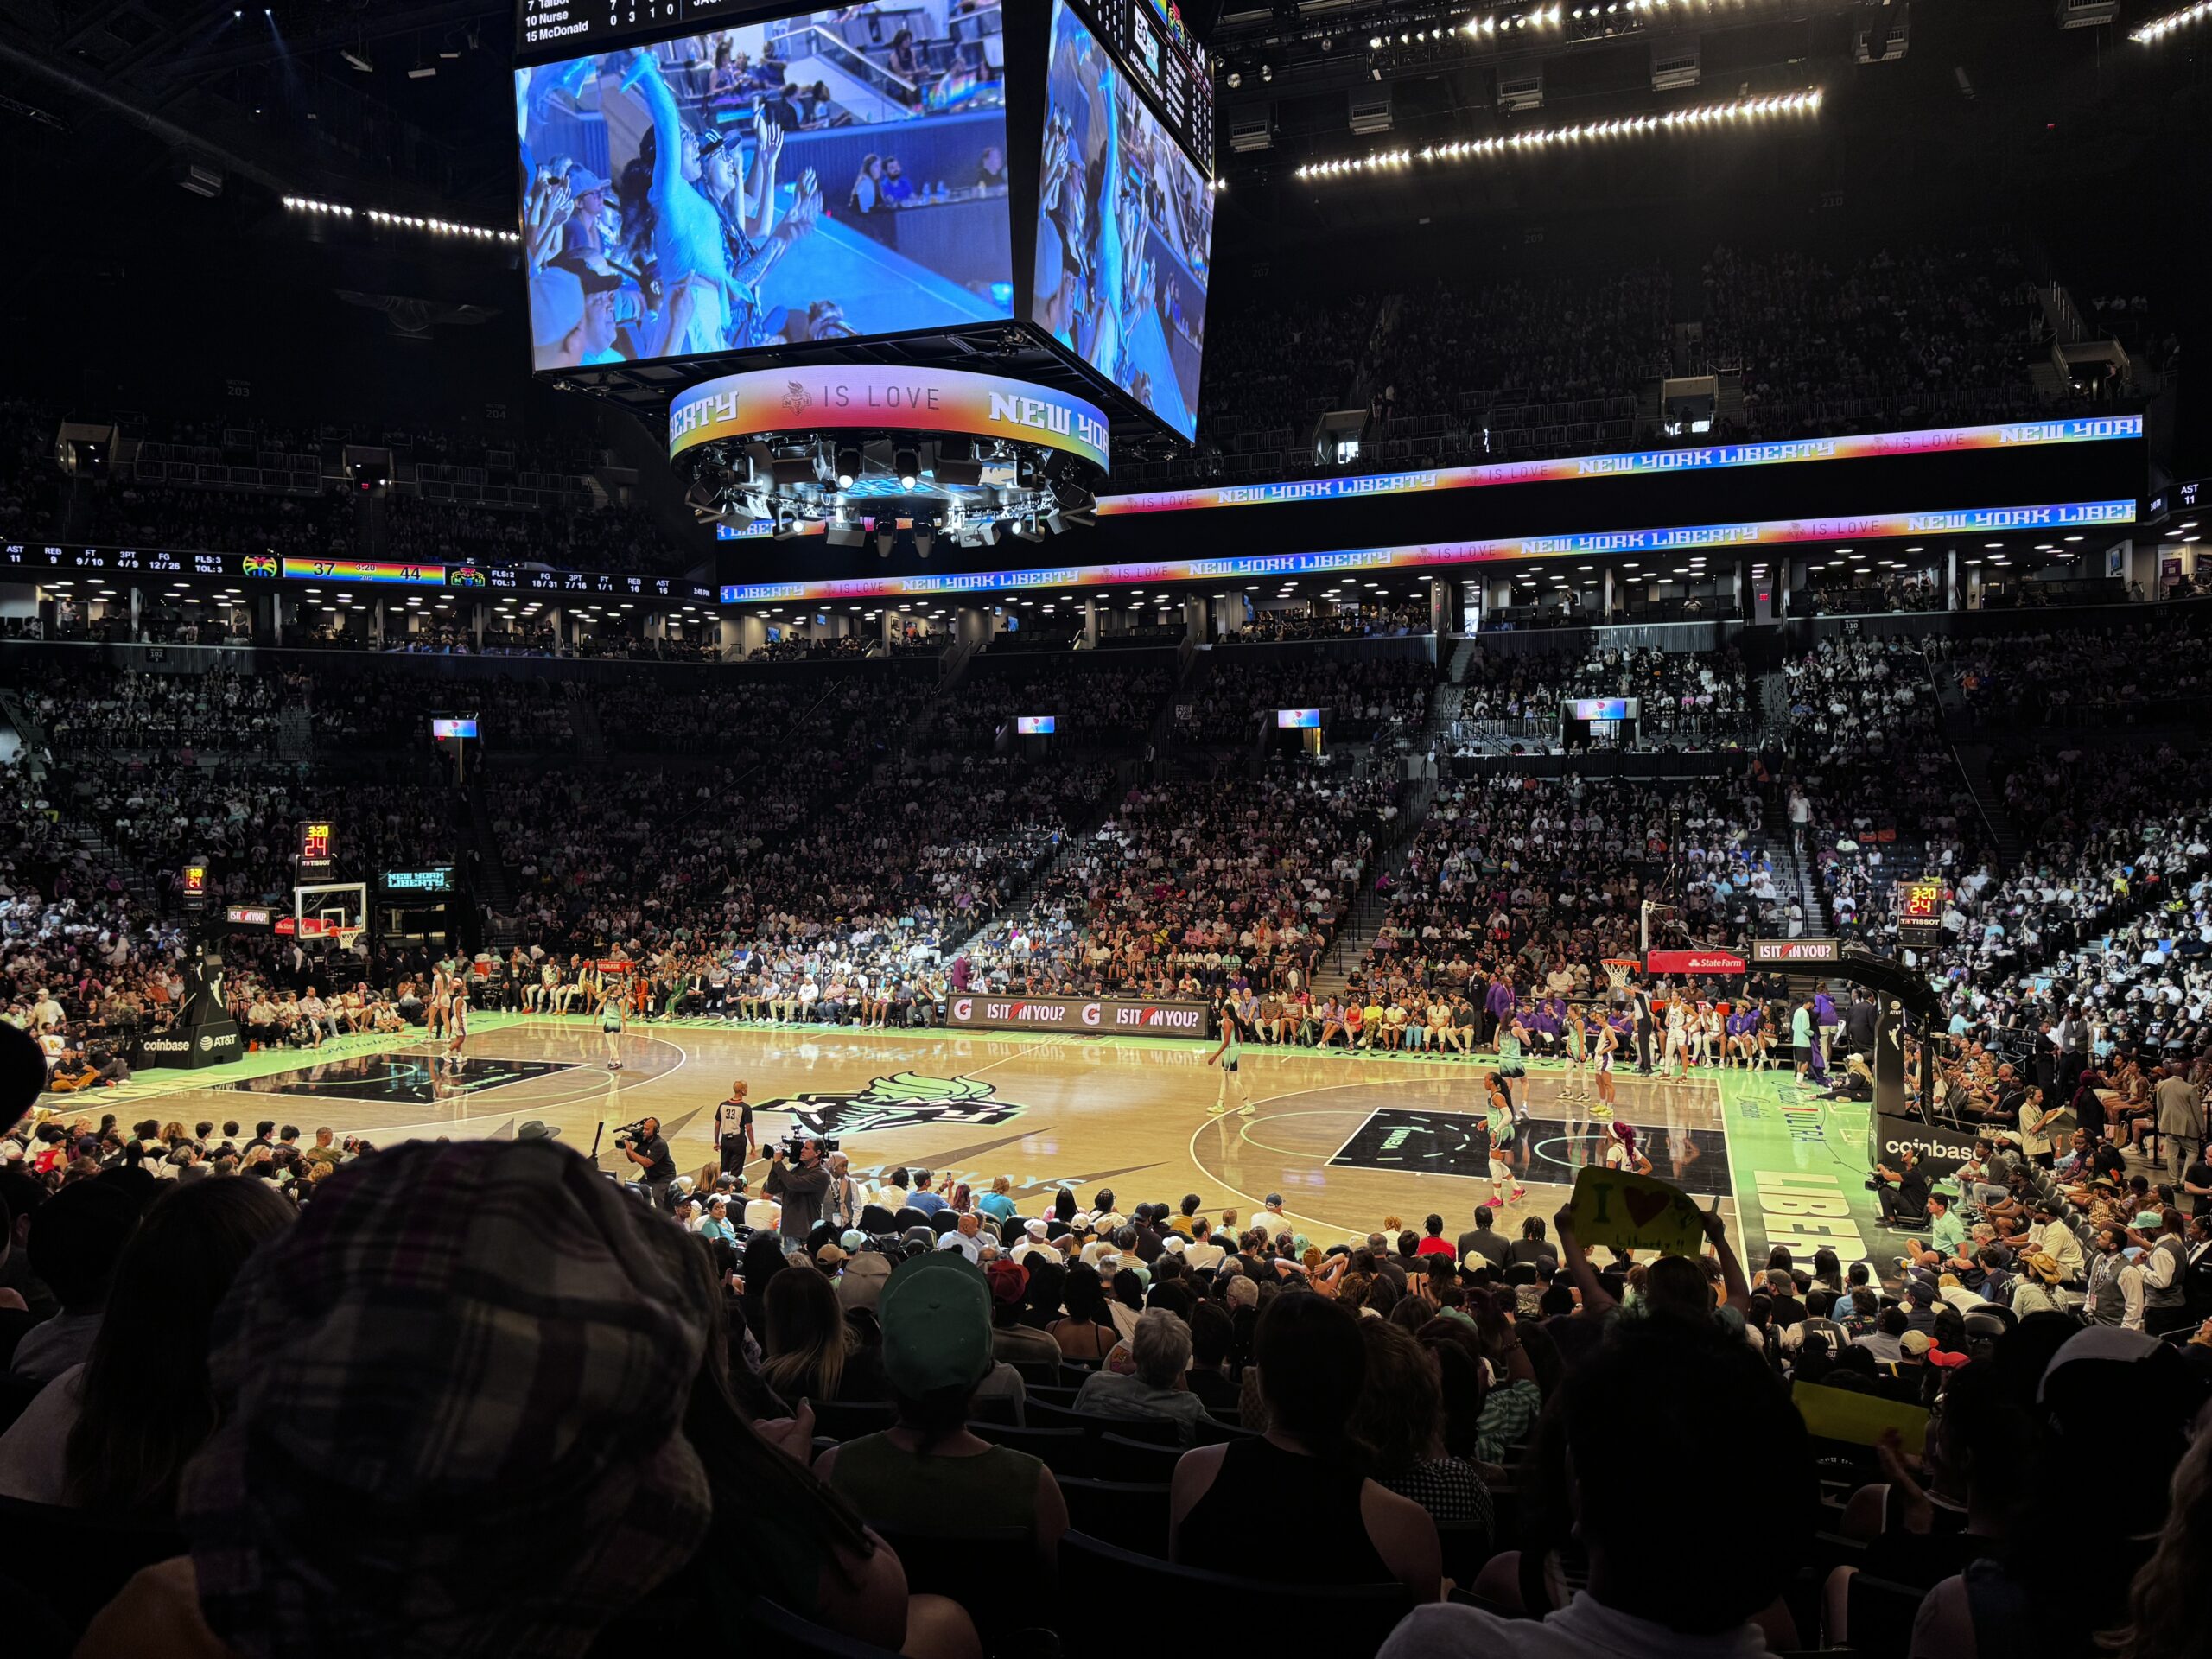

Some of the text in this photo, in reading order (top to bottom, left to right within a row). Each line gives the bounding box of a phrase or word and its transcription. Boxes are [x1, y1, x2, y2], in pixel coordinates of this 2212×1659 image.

[528, 1, 534, 11] 7
[526, 3, 673, 27] 10 Nurse 0 3 1 0
[526, 21, 588, 42] 15 McDonald
[227, 385, 250, 397] 203
[824, 385, 940, 410] IS LOVE
[988, 391, 1071, 436] NEW
[1999, 417, 2142, 443] NEW YOR
[1895, 433, 1964, 450] IS LOVE
[1578, 440, 1836, 475] NEW YORK LIBERTY
[1488, 465, 1548, 480] IS LOVE
[1217, 472, 1437, 505] NEW YORK LIBERTY
[2181, 484, 2199, 494] AST
[1141, 494, 1193, 509] IS LOVE
[2184, 495, 2195, 505] 11
[1812, 520, 1880, 535] IS LOVE
[1907, 513, 1967, 531] NEW
[1975, 510, 2050, 527] YORK
[1520, 525, 1759, 555] NEW YORK LIBERTY
[6, 545, 24, 554] AST
[44, 547, 62, 556] REB
[85, 549, 97, 557] FT
[119, 550, 136, 559] 3PT
[158, 552, 170, 561] FG
[194, 556, 215, 564] FLS:
[1437, 544, 1497, 560] IS LOVE
[10, 554, 22, 563] 11
[50, 556, 57, 564] 9
[195, 564, 216, 573] TOL:
[217, 565, 223, 574] 3
[1188, 550, 1392, 575] NEW YORK LIBERTY
[313, 563, 334, 576] 37
[400, 567, 421, 580] 44
[540, 572, 551, 581] FG
[627, 577, 641, 586] REB
[1118, 565, 1169, 578] IS LOVE
[839, 581, 885, 594] IS LOVE
[901, 569, 1079, 592] NEW YORK LIBERTY
[630, 585, 639, 594] 16
[734, 585, 805, 600] LIBERTY
[308, 825, 329, 837] 3:20
[304, 837, 327, 857] 24
[388, 872, 412, 880] NEW
[387, 880, 444, 888] LIBERTY
[1912, 887, 1936, 900] 3:20
[1910, 899, 1931, 914] 24
[953, 998, 972, 1020] G
[1081, 1002, 1101, 1026] G
[143, 1039, 190, 1052] coinbase
[213, 1033, 237, 1047] AT&T
[725, 1108, 736, 1120] 33
